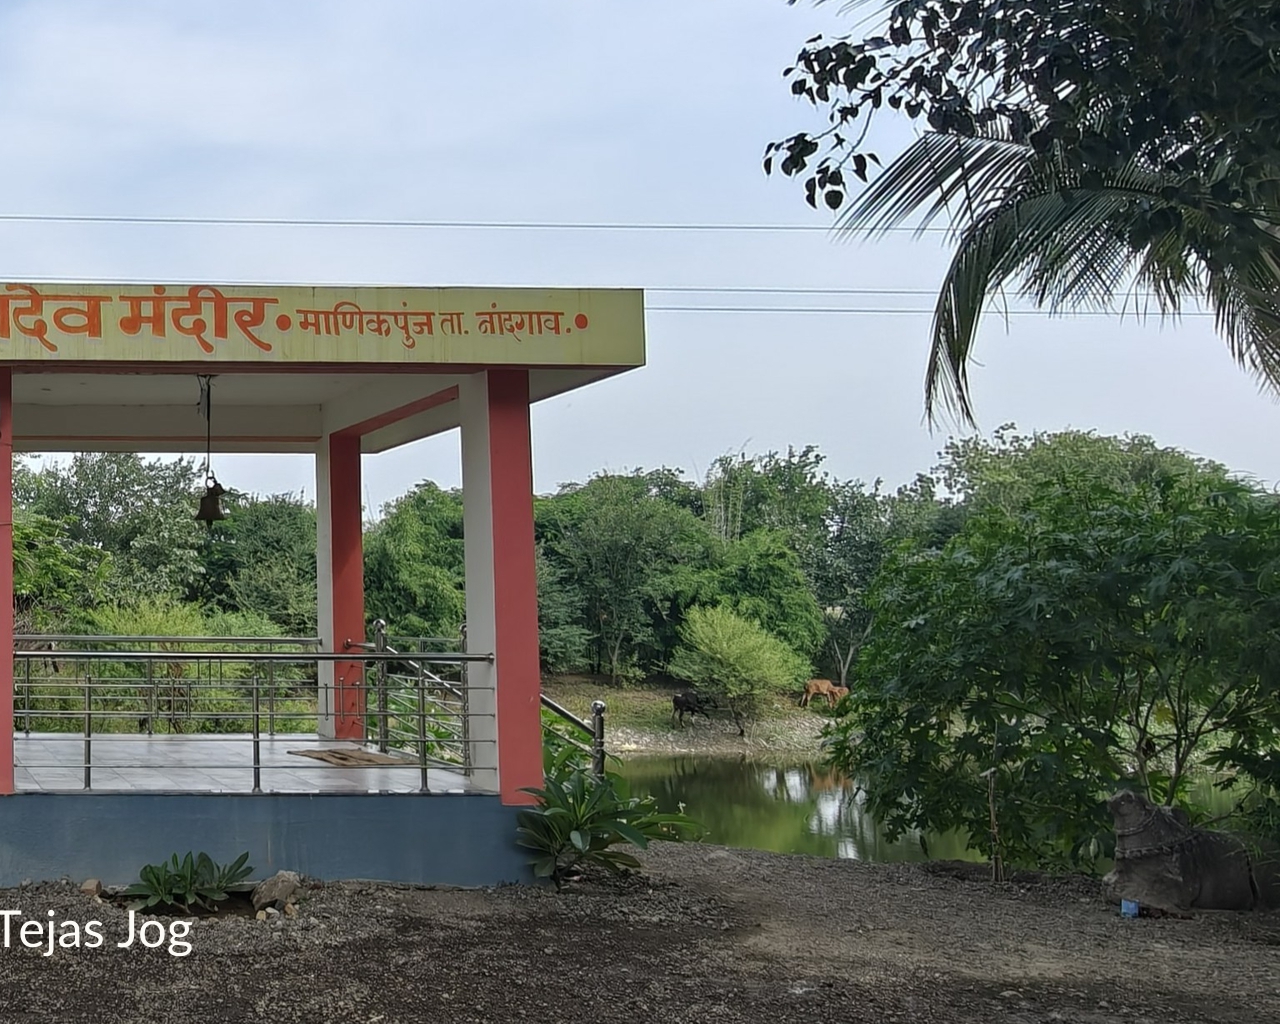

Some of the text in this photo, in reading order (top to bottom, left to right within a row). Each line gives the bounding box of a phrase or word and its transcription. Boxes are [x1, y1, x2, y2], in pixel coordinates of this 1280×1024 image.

[118, 285, 279, 353] मंदीर
[296, 301, 435, 349] माणिकपुंज
[438, 312, 469, 336] ता.
